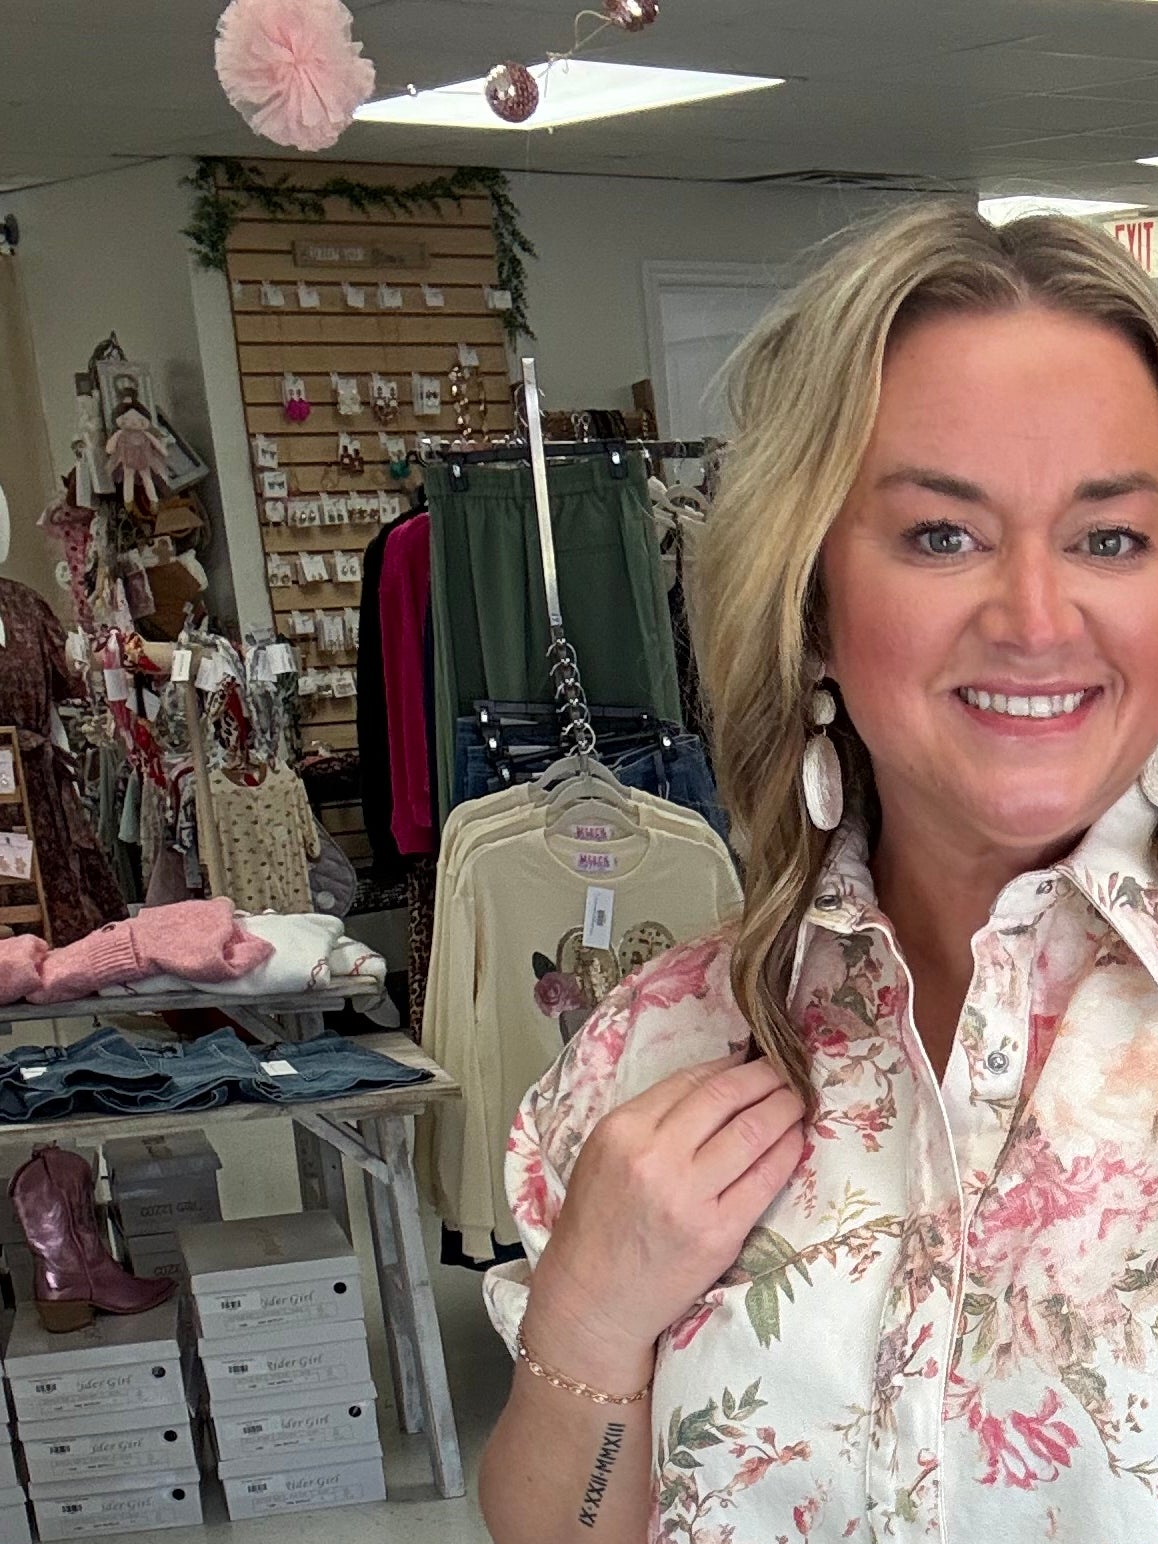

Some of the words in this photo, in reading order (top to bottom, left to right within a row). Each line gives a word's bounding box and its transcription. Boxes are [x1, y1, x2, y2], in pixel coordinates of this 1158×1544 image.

[290, 1290, 316, 1306] Girl
[299, 1353, 324, 1368] Girl
[106, 1375, 132, 1388] Girl
[306, 1413, 330, 1428] Girl
[118, 1438, 144, 1452] Girl
[316, 1473, 341, 1489] Girl
